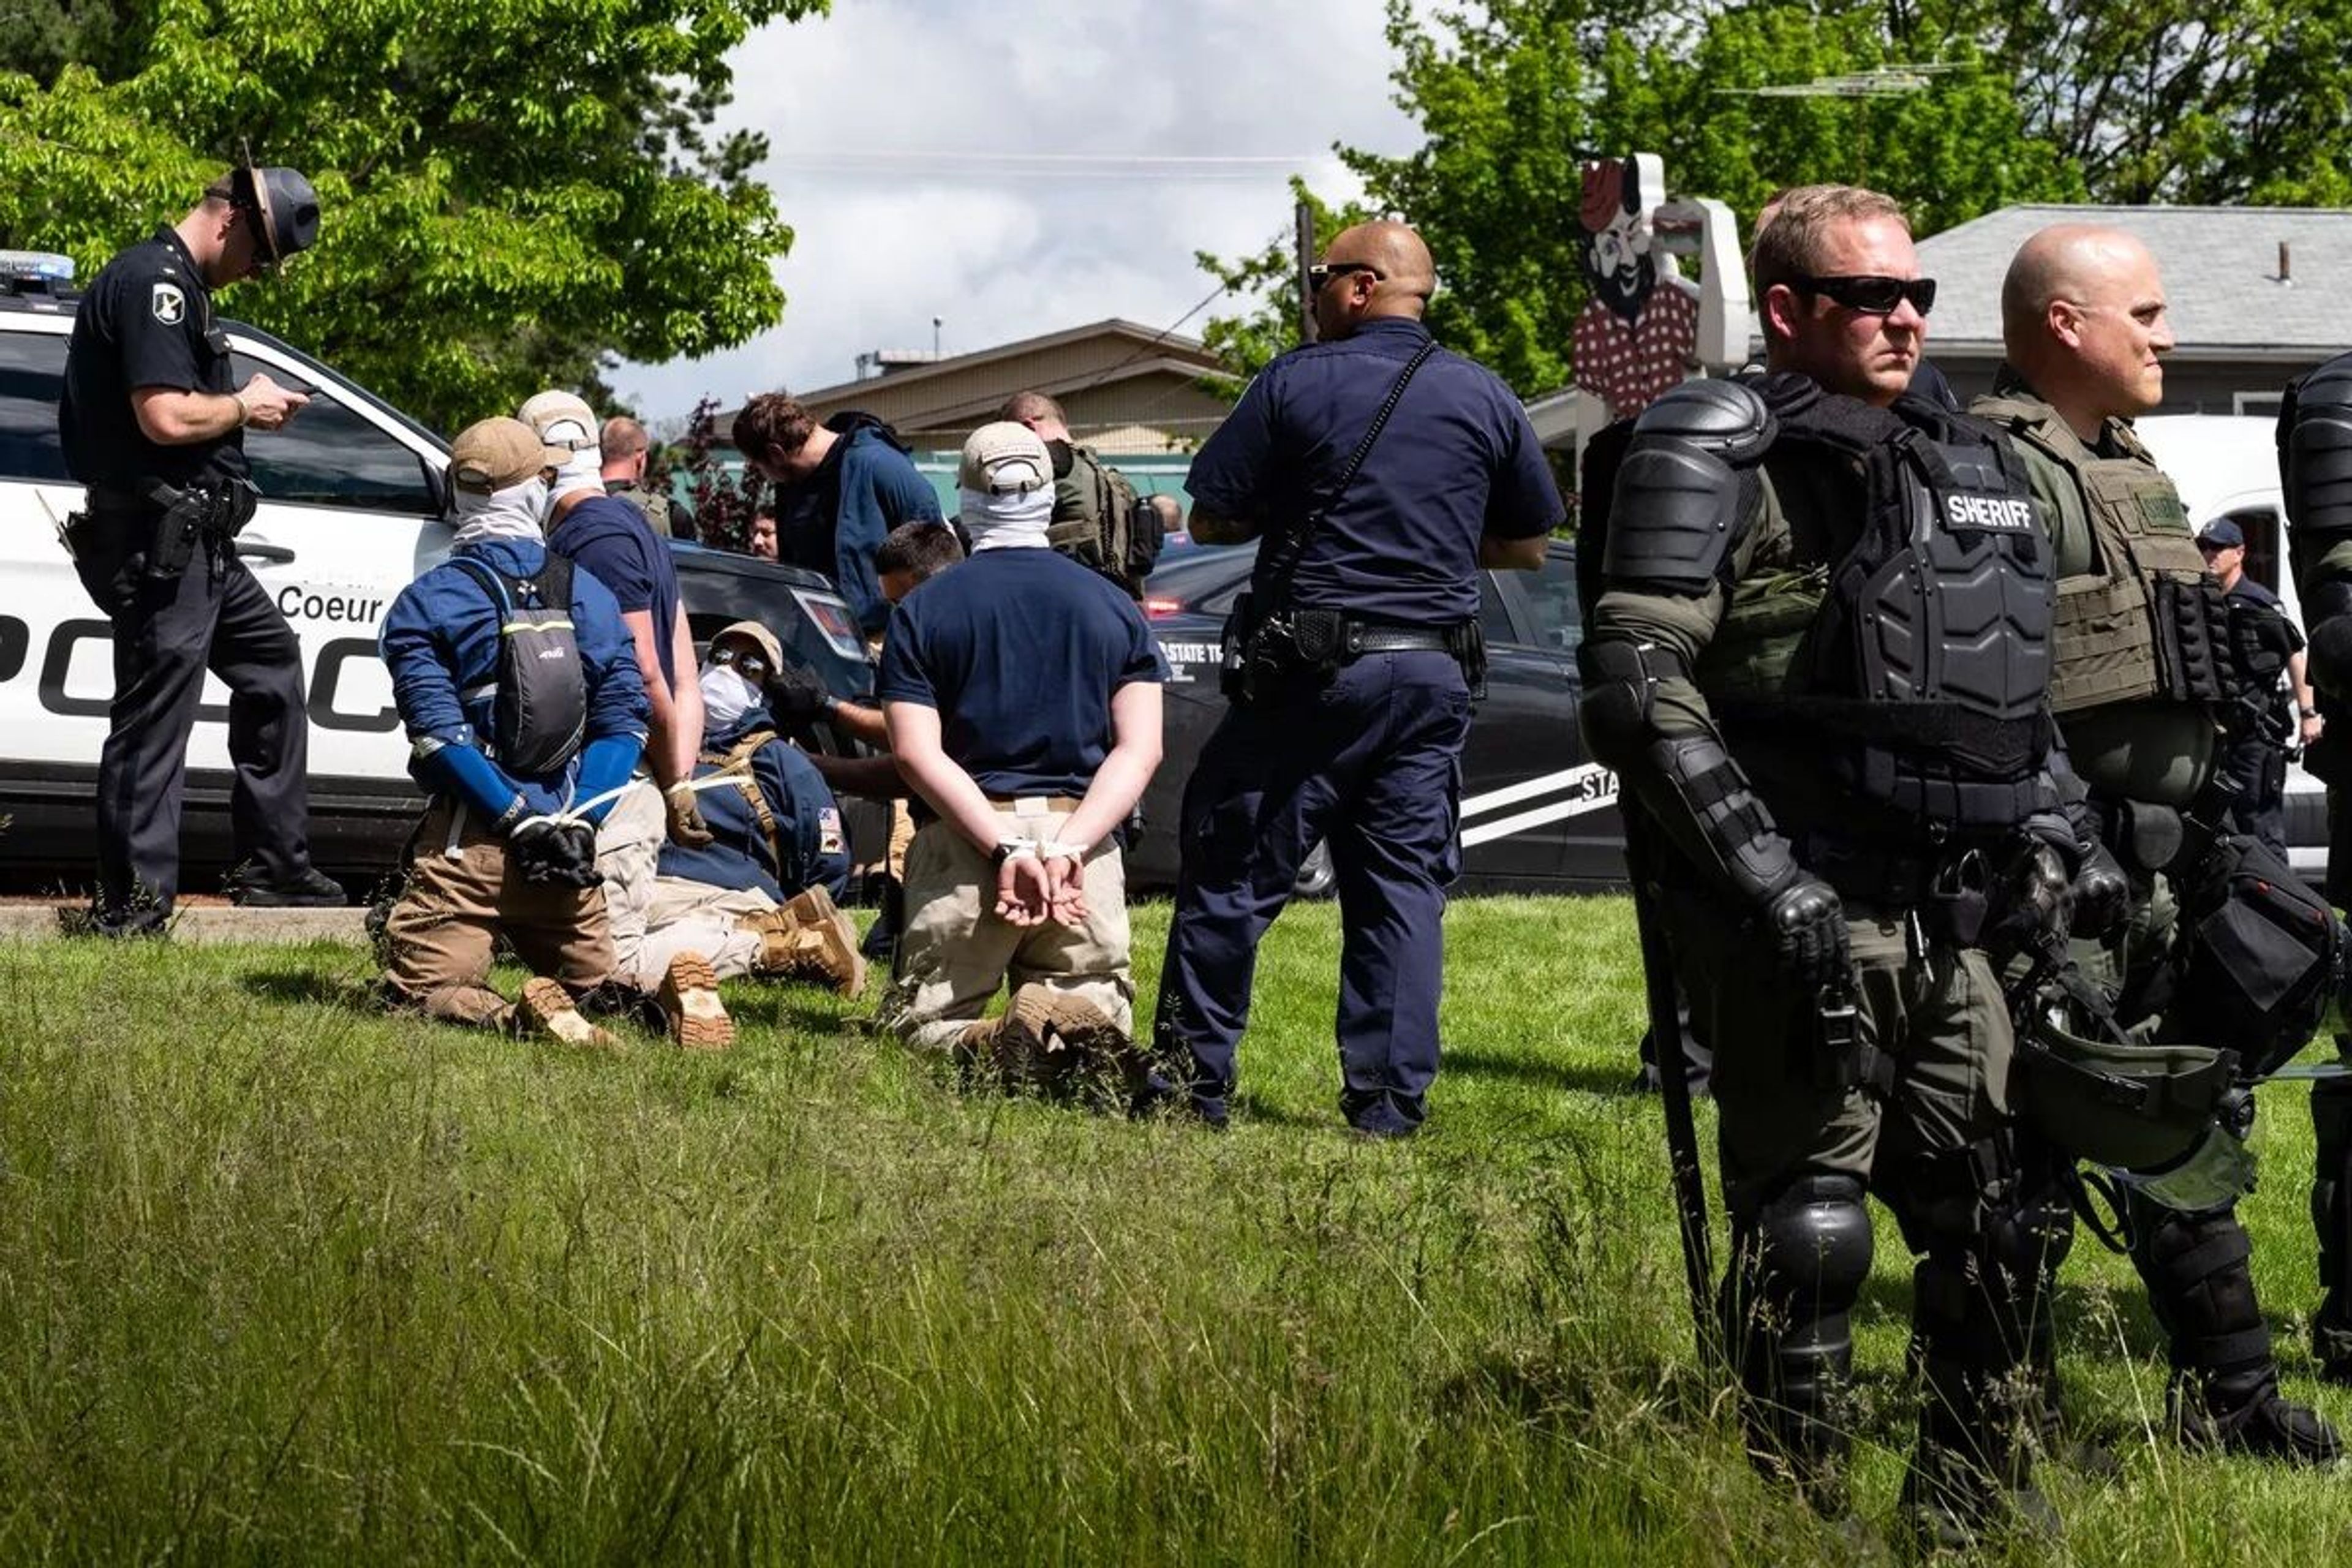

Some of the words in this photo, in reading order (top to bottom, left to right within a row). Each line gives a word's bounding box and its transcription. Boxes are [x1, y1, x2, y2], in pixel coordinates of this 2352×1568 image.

[1948, 495, 2031, 528] SHERIFF
[277, 586, 383, 623] Coeur
[1167, 643, 1205, 663] STATE
[1583, 771, 1620, 799] STA
